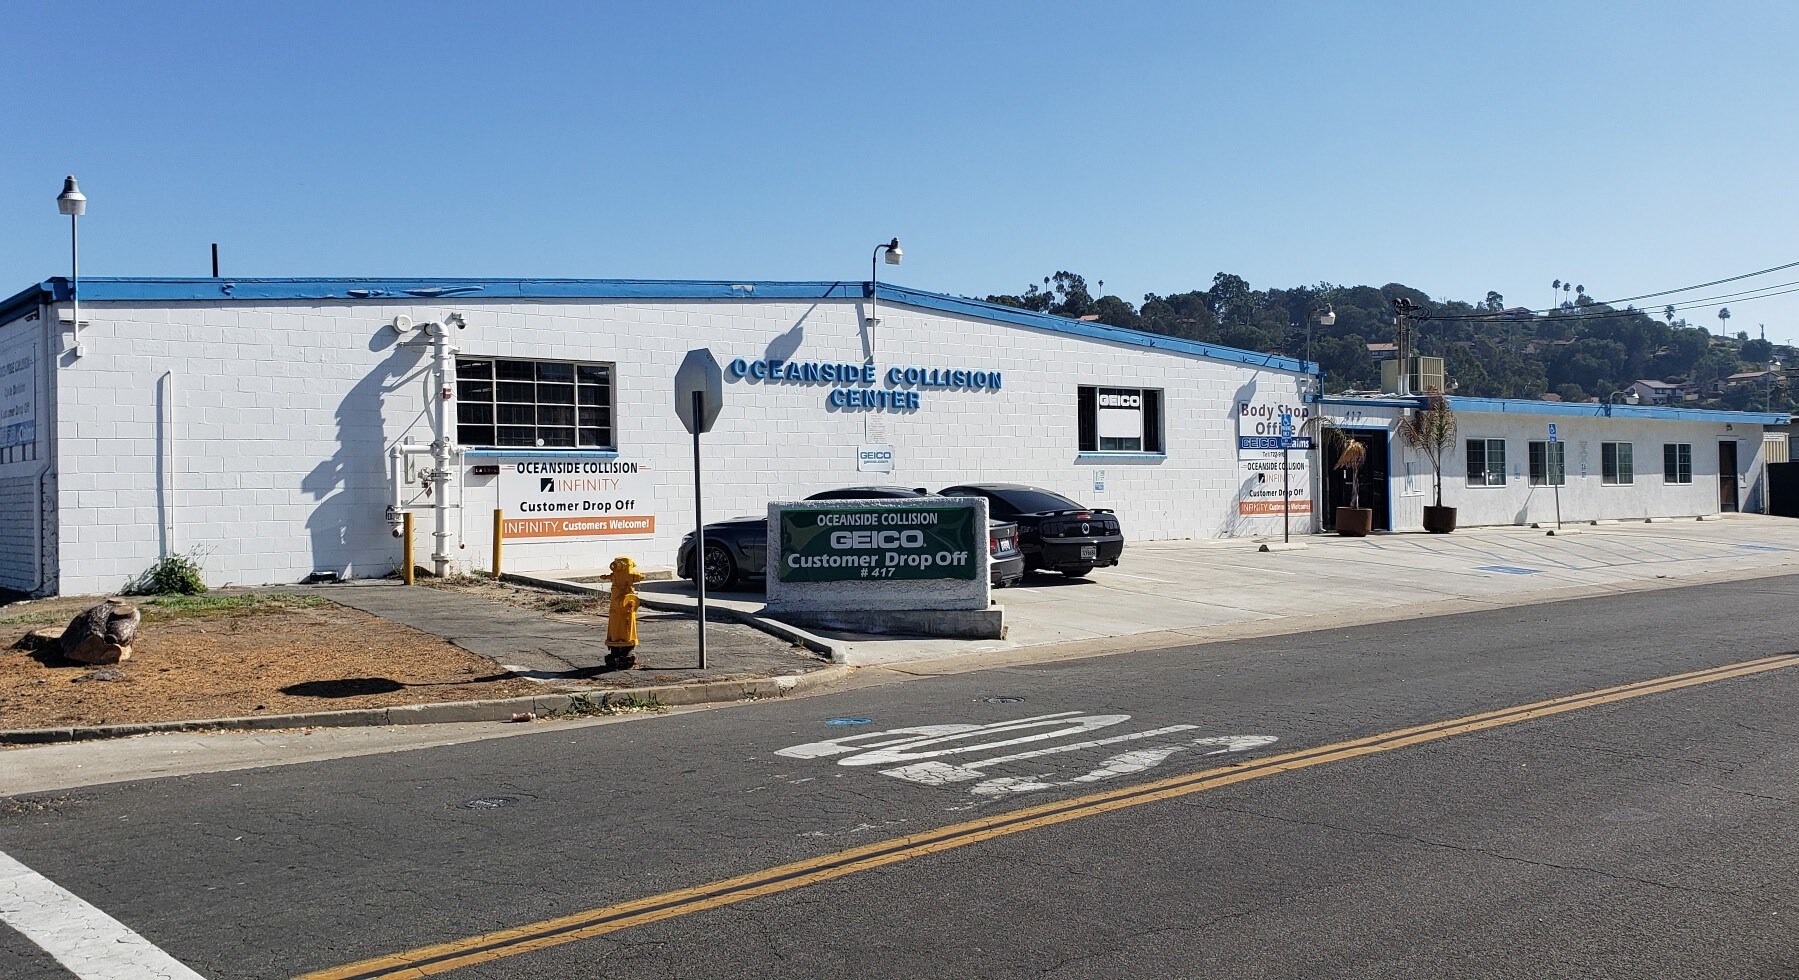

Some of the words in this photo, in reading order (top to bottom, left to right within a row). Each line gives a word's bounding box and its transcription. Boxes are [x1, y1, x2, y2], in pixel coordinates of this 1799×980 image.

[731, 358, 876, 383] OCEANSIDE
[888, 367, 1002, 389] COLLISION
[830, 389, 921, 409] CENTER
[1100, 394, 1139, 406] GEICO
[1241, 404, 1273, 421] Body
[1278, 405, 1309, 421] Shop
[1256, 422, 1296, 435] Offie
[1242, 438, 1278, 448] GEICO
[1286, 439, 1309, 448] aims
[517, 462, 580, 474] OCEANSIDE
[583, 462, 638, 474] COLLISION
[1247, 462, 1277, 471] OCEANSIDE
[1279, 462, 1305, 471] COLISION
[558, 478, 620, 492] INFINITY
[1266, 474, 1296, 483] INFINTY
[1249, 489, 1277, 497] Customer
[1279, 489, 1293, 498] Drp
[1294, 488, 1304, 496] Off
[520, 501, 579, 512] Customer
[583, 501, 611, 514] Drop
[615, 500, 635, 510] Off
[504, 520, 560, 534] INFINITY
[562, 519, 607, 531] Customers
[609, 518, 649, 530] Welcome!
[817, 513, 878, 526] OCEANSIDE
[882, 513, 938, 525] COLLISION
[830, 530, 926, 549] GEICO
[788, 553, 878, 568] Customer
[885, 552, 932, 569] Drop
[935, 551, 968, 566] Off
[860, 568, 869, 577] #
[871, 568, 895, 577] 417
